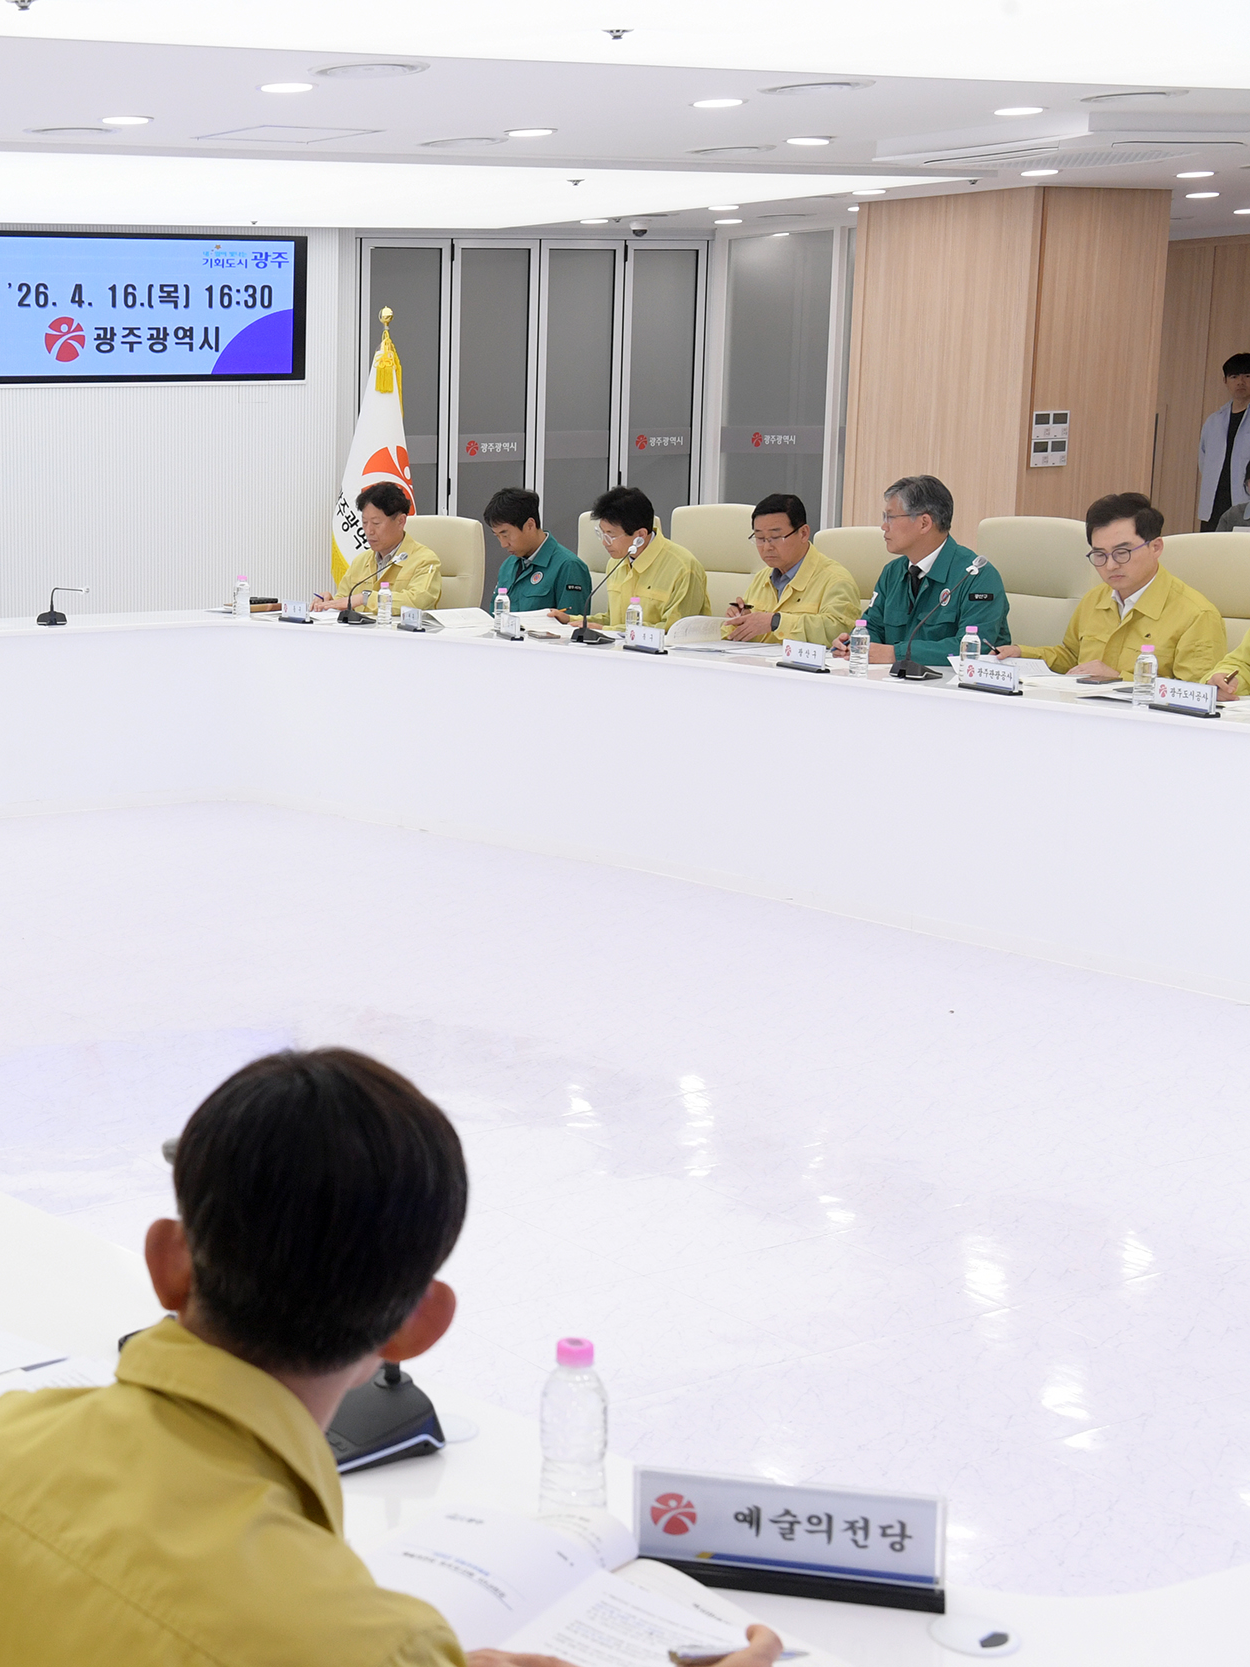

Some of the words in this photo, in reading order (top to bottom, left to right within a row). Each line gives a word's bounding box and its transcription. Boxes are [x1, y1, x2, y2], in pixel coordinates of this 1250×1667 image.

[202, 258, 248, 269] 기회도시
[251, 251, 290, 269] 광주
[70, 283, 93, 309] 4.
[205, 284, 274, 309] 16:30
[93, 326, 221, 353] 광주광역시
[649, 436, 683, 447] 광주광역시
[764, 434, 796, 445] 광주광역시
[480, 442, 517, 453] 광주광역시
[977, 667, 1013, 682] 광주관광공사
[1170, 687, 1209, 702] 광주도시공사
[733, 1504, 913, 1553] 예술의전당
